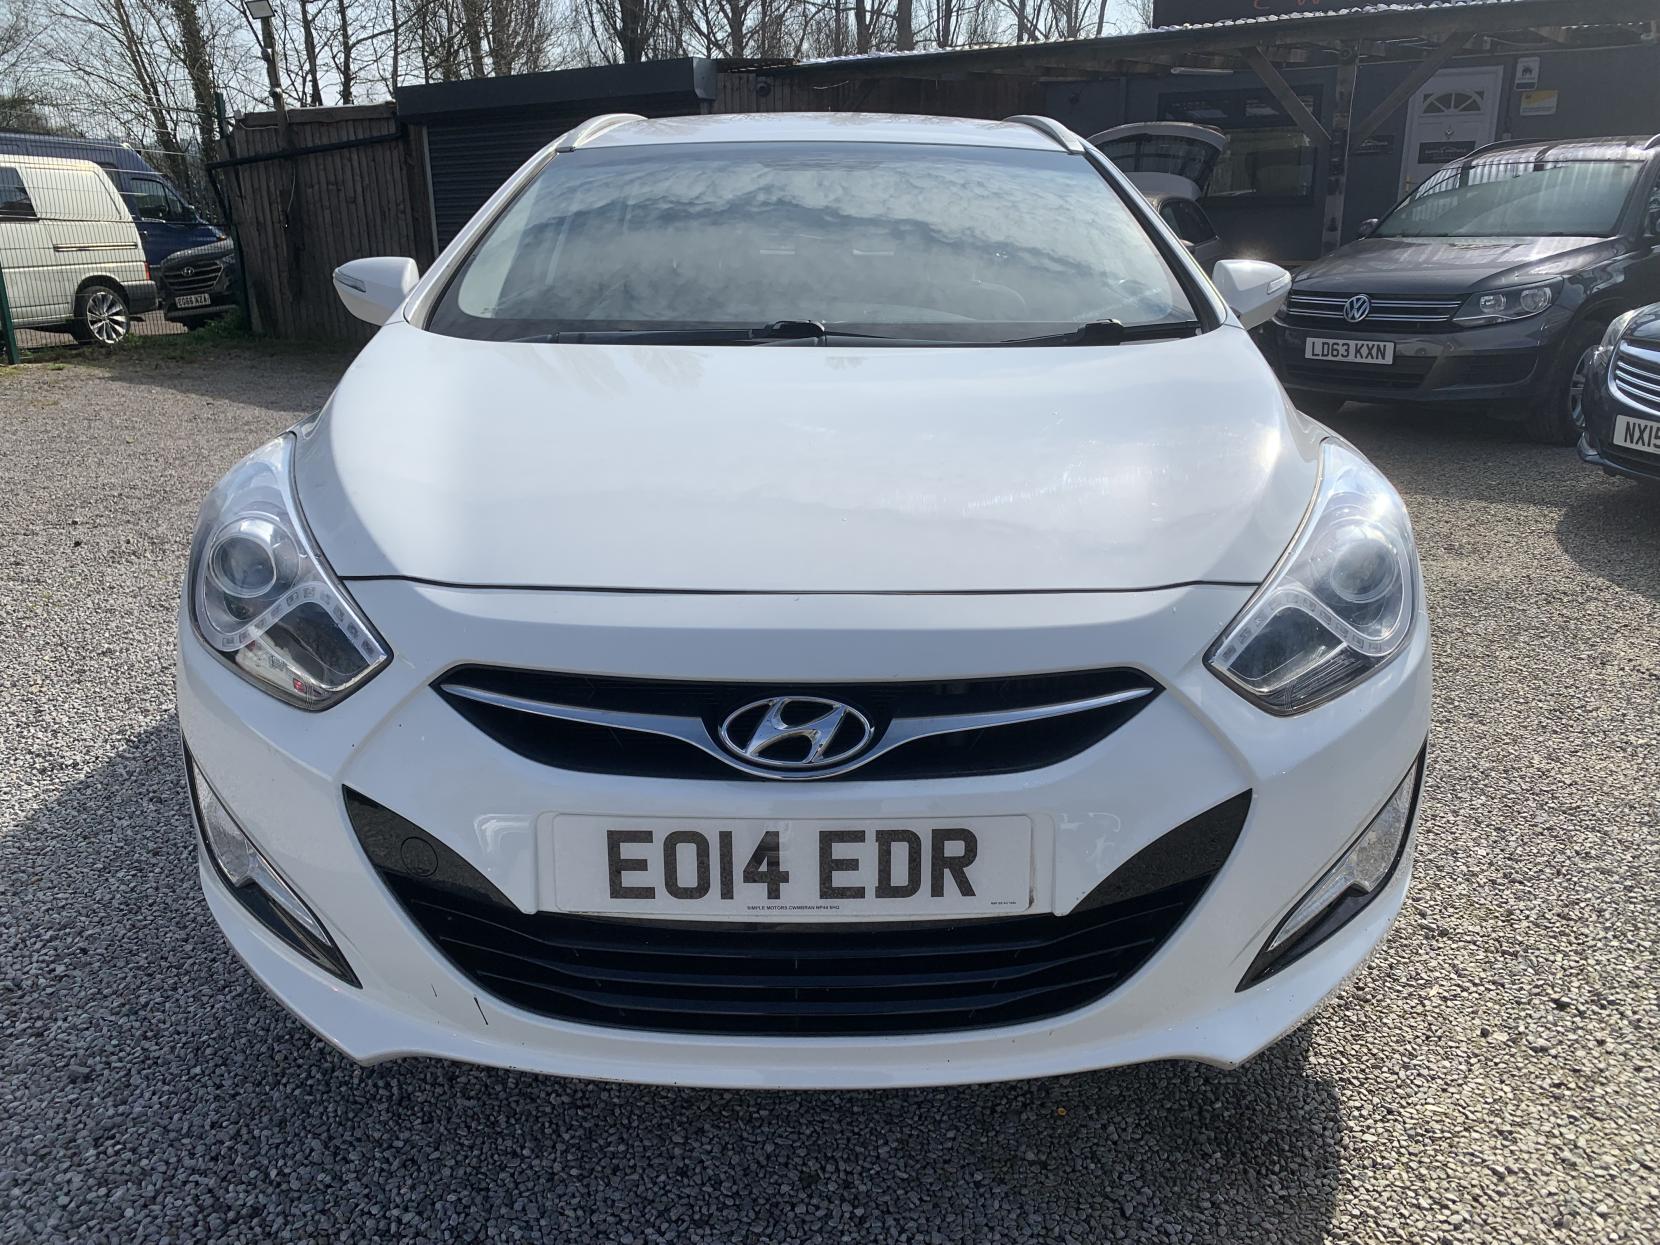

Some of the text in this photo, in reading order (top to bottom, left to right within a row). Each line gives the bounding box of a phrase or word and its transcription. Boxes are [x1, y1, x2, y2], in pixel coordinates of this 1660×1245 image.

[1311, 341, 1387, 360] LD63 KXN
[1624, 421, 1660, 449] NX15
[606, 828, 978, 900] EO14 EDR
